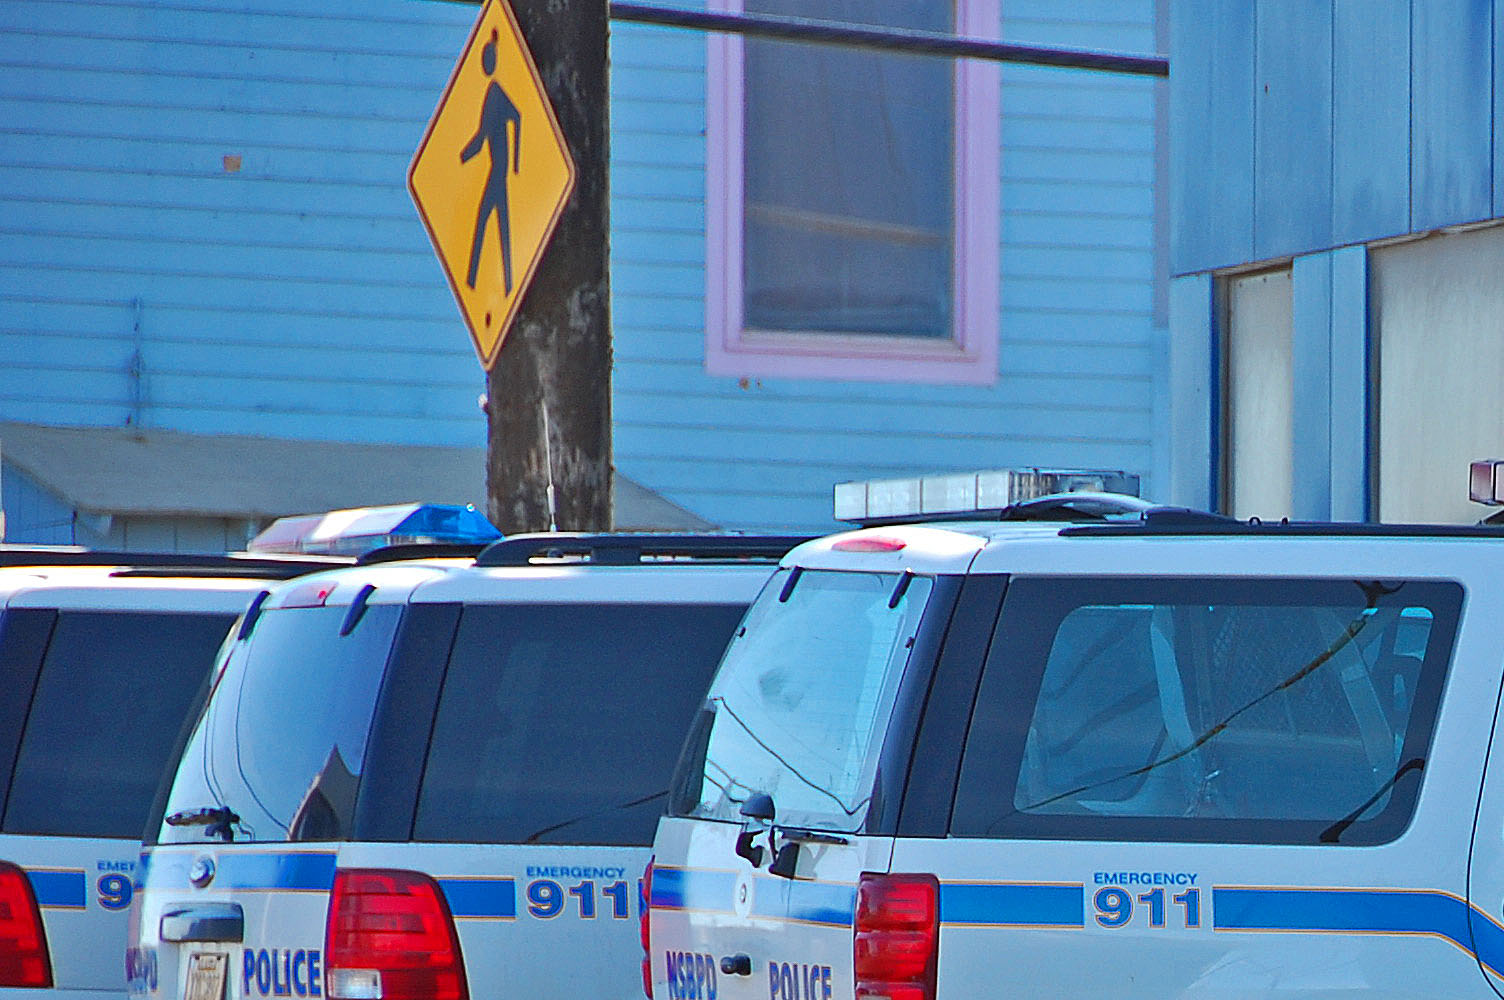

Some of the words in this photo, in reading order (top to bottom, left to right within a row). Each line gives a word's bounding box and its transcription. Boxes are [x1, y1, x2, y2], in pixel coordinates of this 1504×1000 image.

[526, 866, 625, 878] EMERGENCY
[1093, 872, 1198, 885] EMERGENCY
[526, 880, 629, 919] 911
[1093, 886, 1201, 929] 911
[242, 948, 322, 998] POLICE
